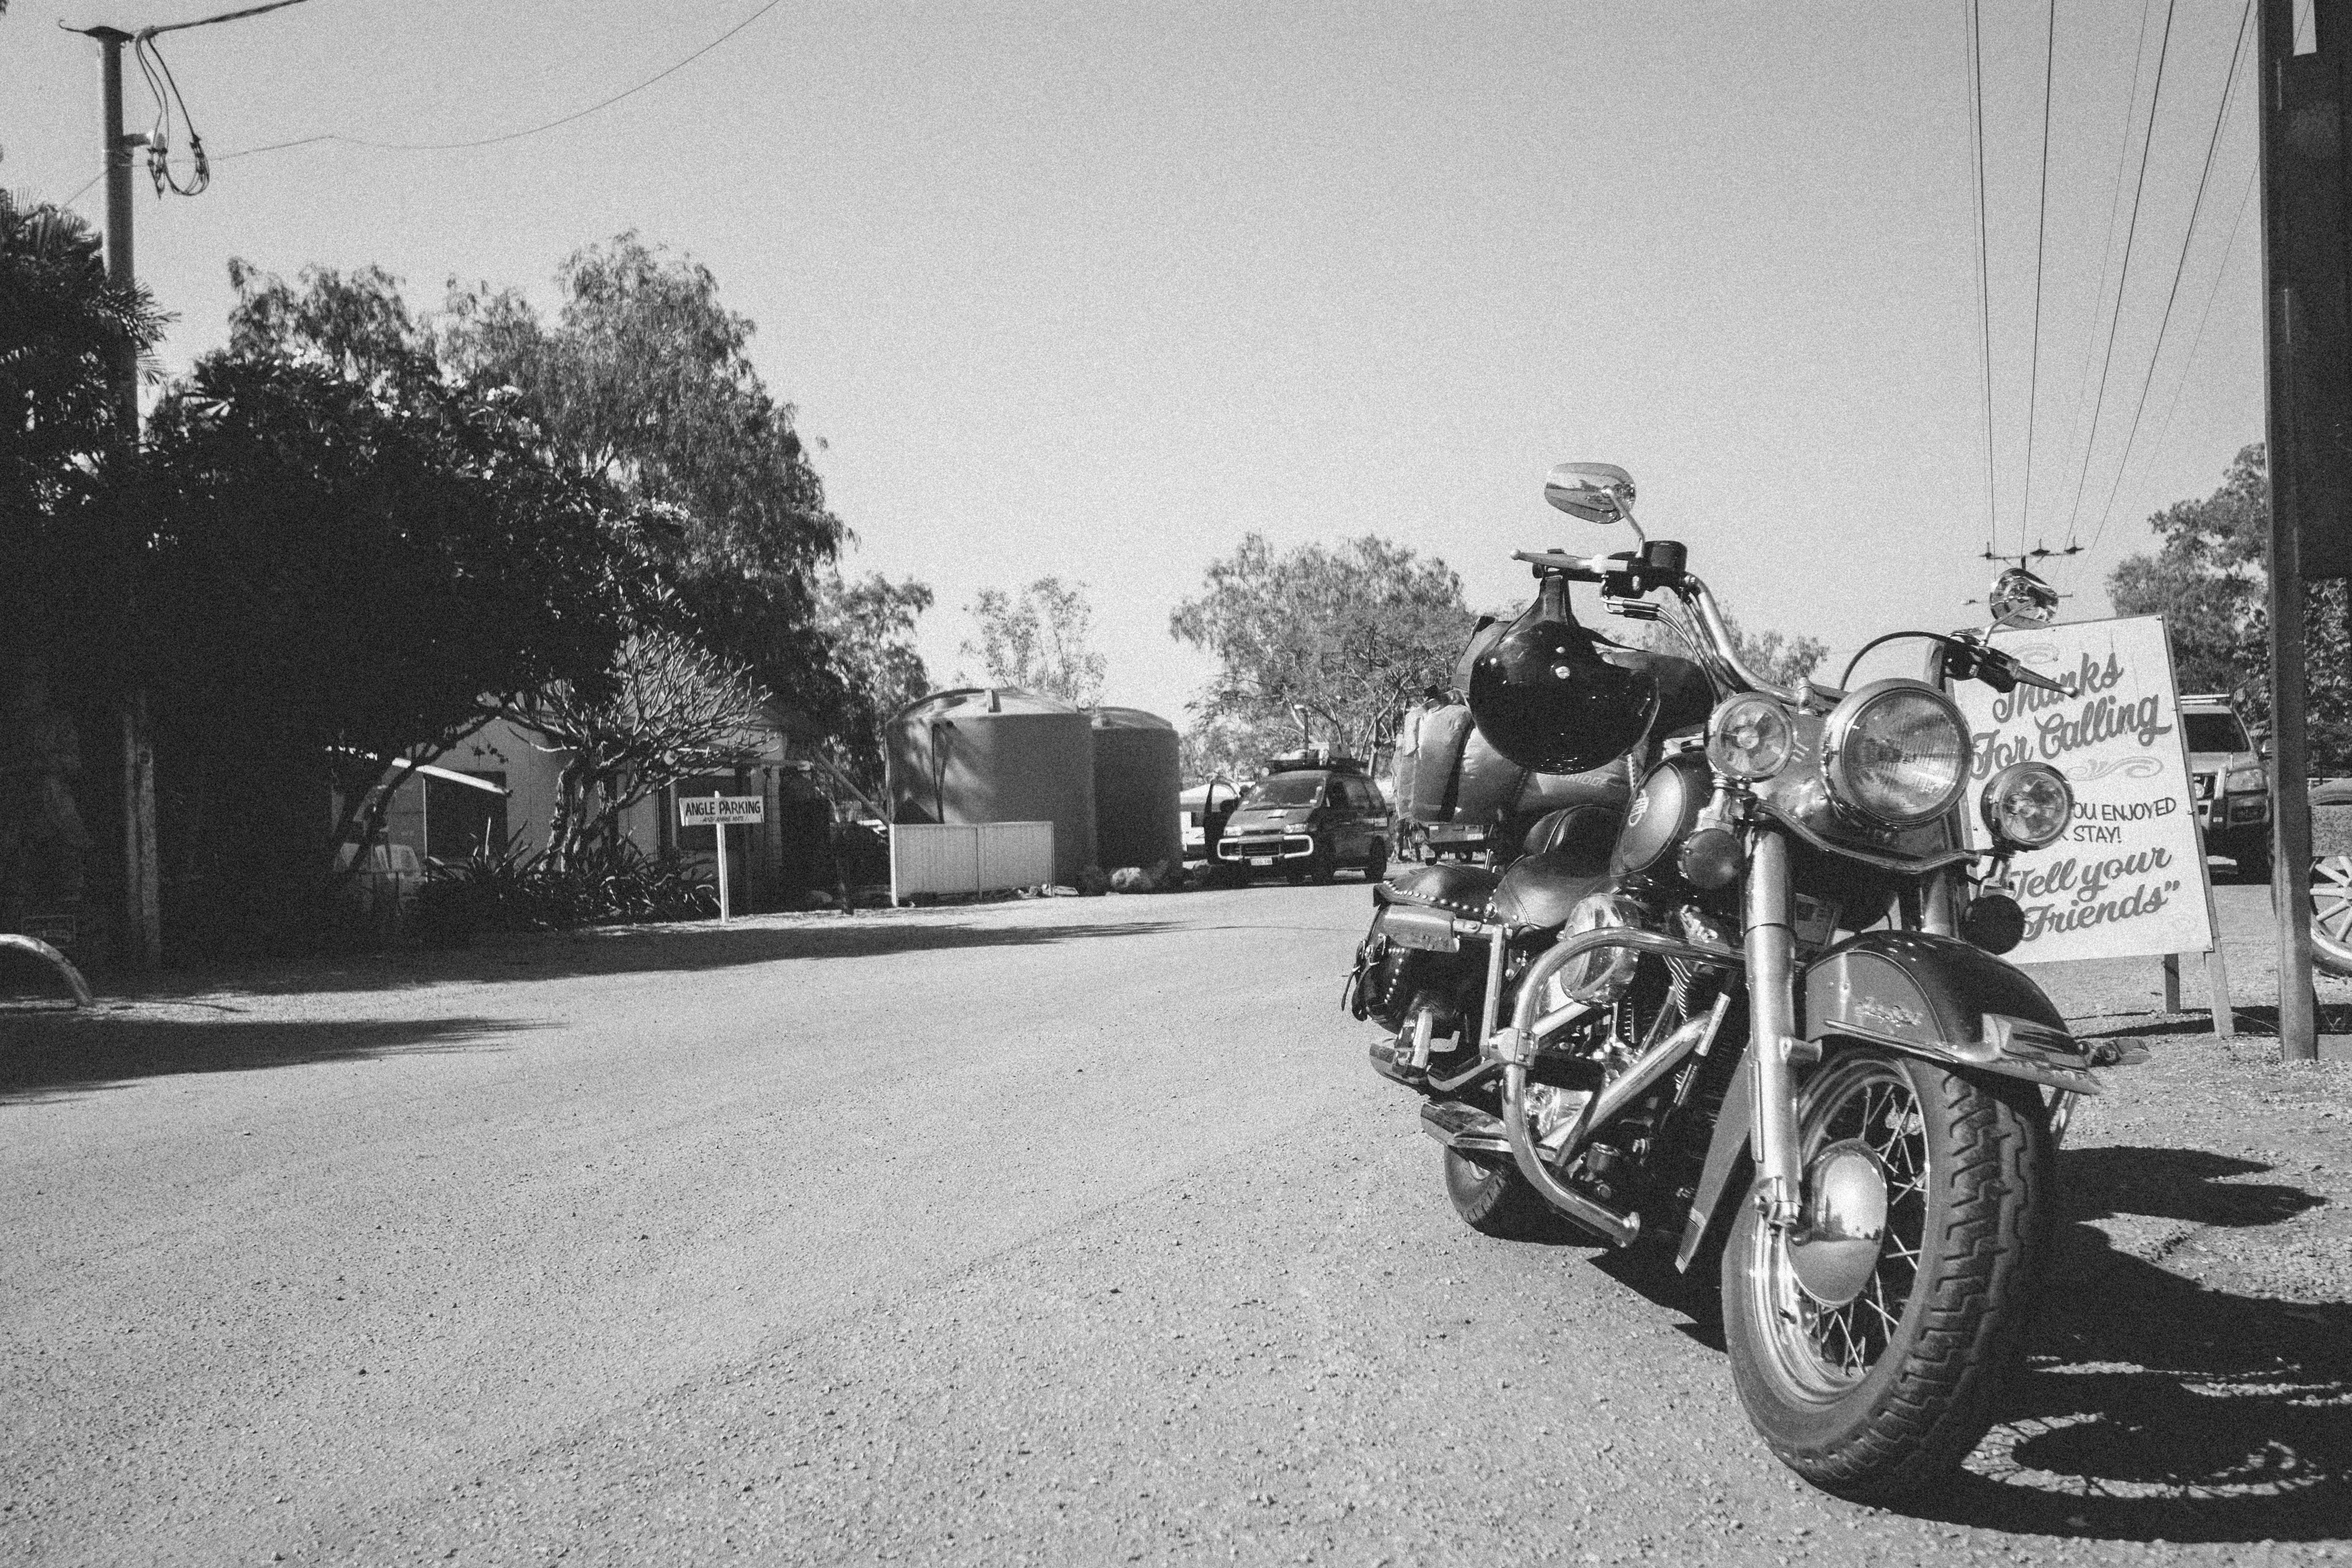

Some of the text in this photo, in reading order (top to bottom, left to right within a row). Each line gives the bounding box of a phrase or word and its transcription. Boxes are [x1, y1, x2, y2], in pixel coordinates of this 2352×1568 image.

[1970, 694, 2172, 780] For Calling
[686, 801, 761, 816] ANGLE PARKING
[2073, 797, 2176, 821] OU ENJOYED
[2073, 825, 2122, 843] STAY!
[2010, 847, 2172, 902] Tell your
